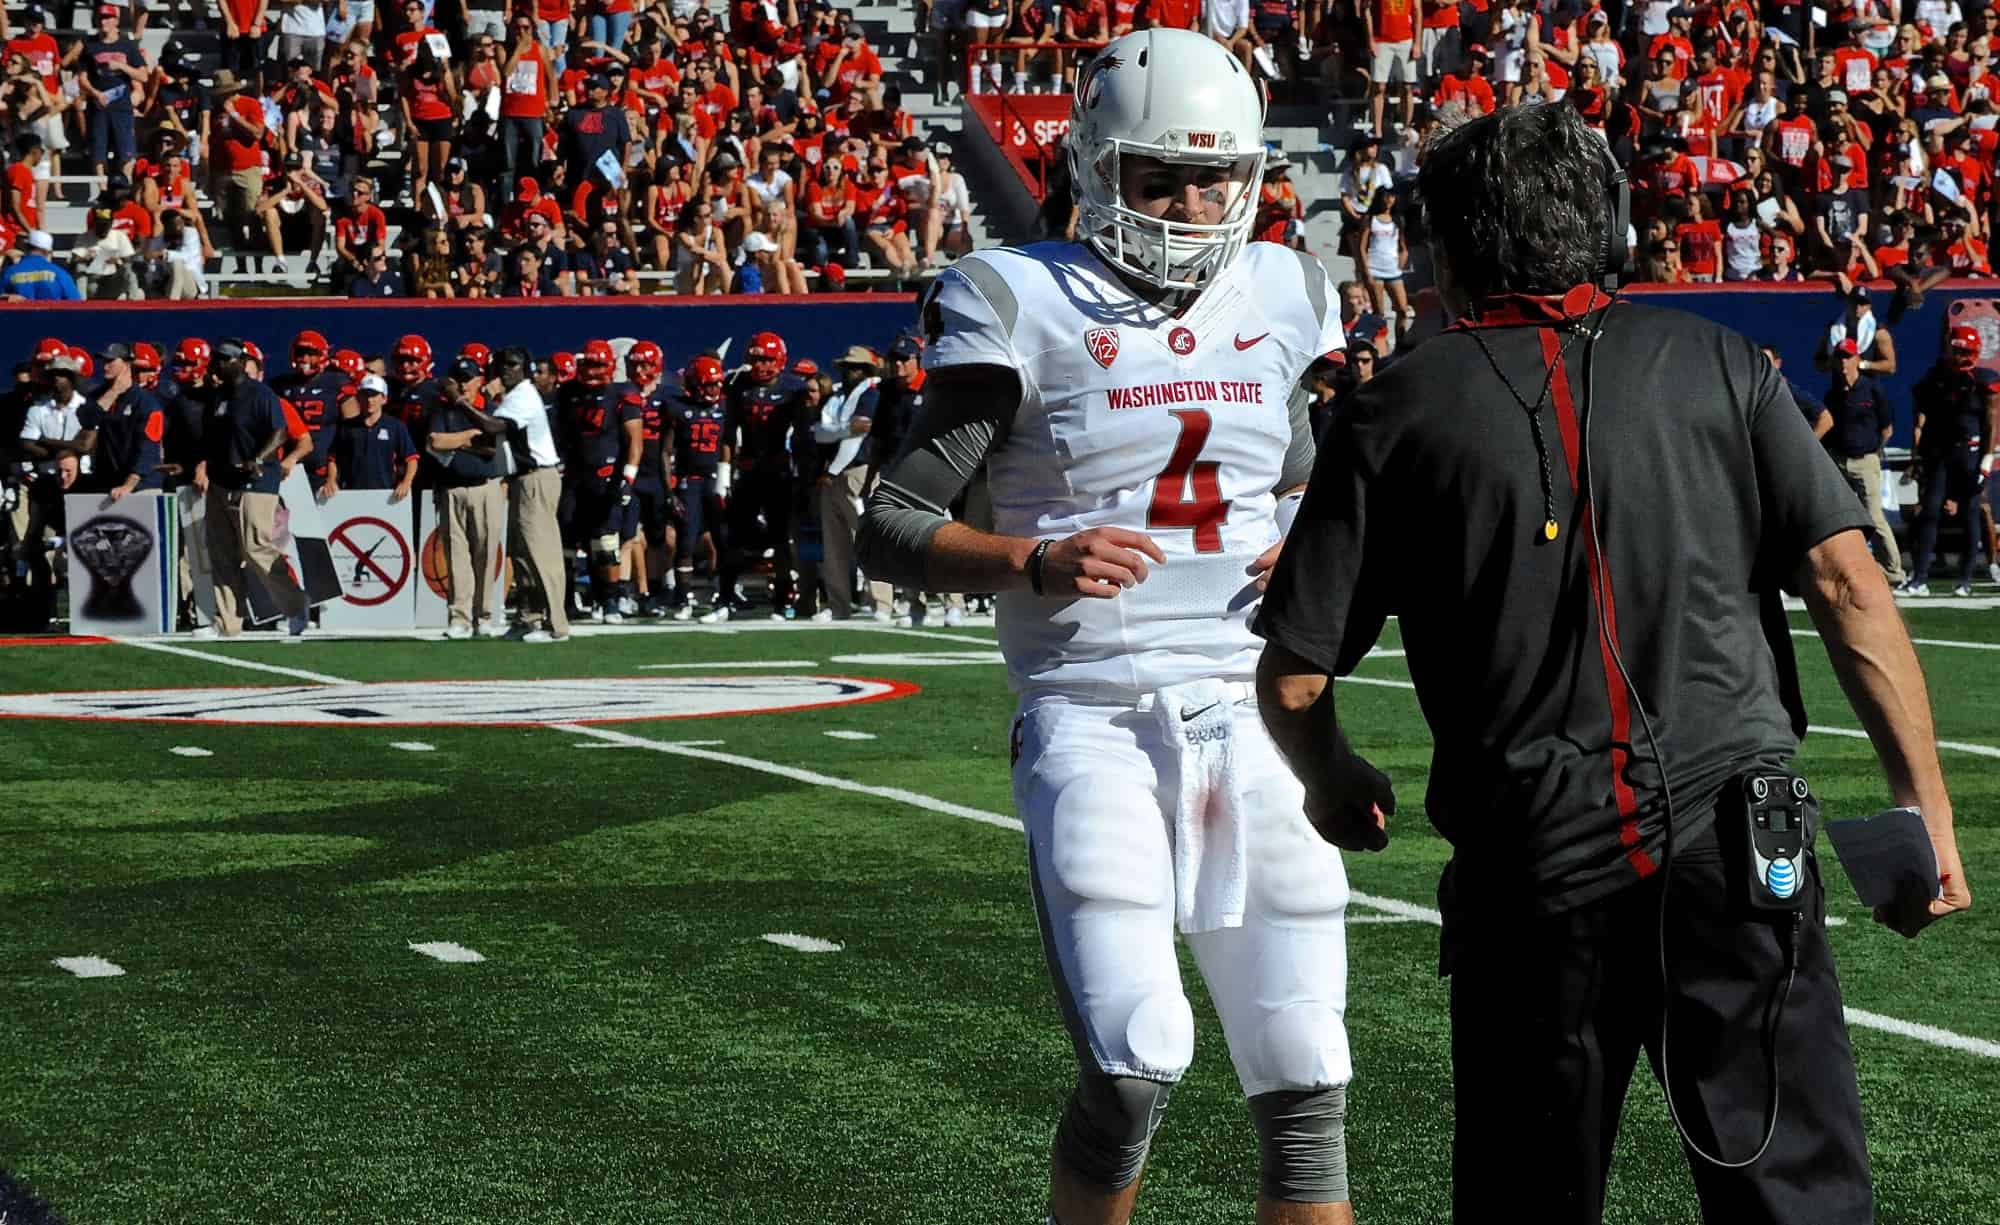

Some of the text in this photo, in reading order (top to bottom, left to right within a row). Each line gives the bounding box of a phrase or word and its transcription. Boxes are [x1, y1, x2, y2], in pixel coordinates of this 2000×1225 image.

[1187, 131, 1216, 149] WSU
[1088, 328, 1120, 352] PAC
[1097, 344, 1115, 360] 12
[1106, 380, 1264, 411] WASHINGTON STATE
[689, 422, 722, 454] 15
[1146, 407, 1233, 555] 4
